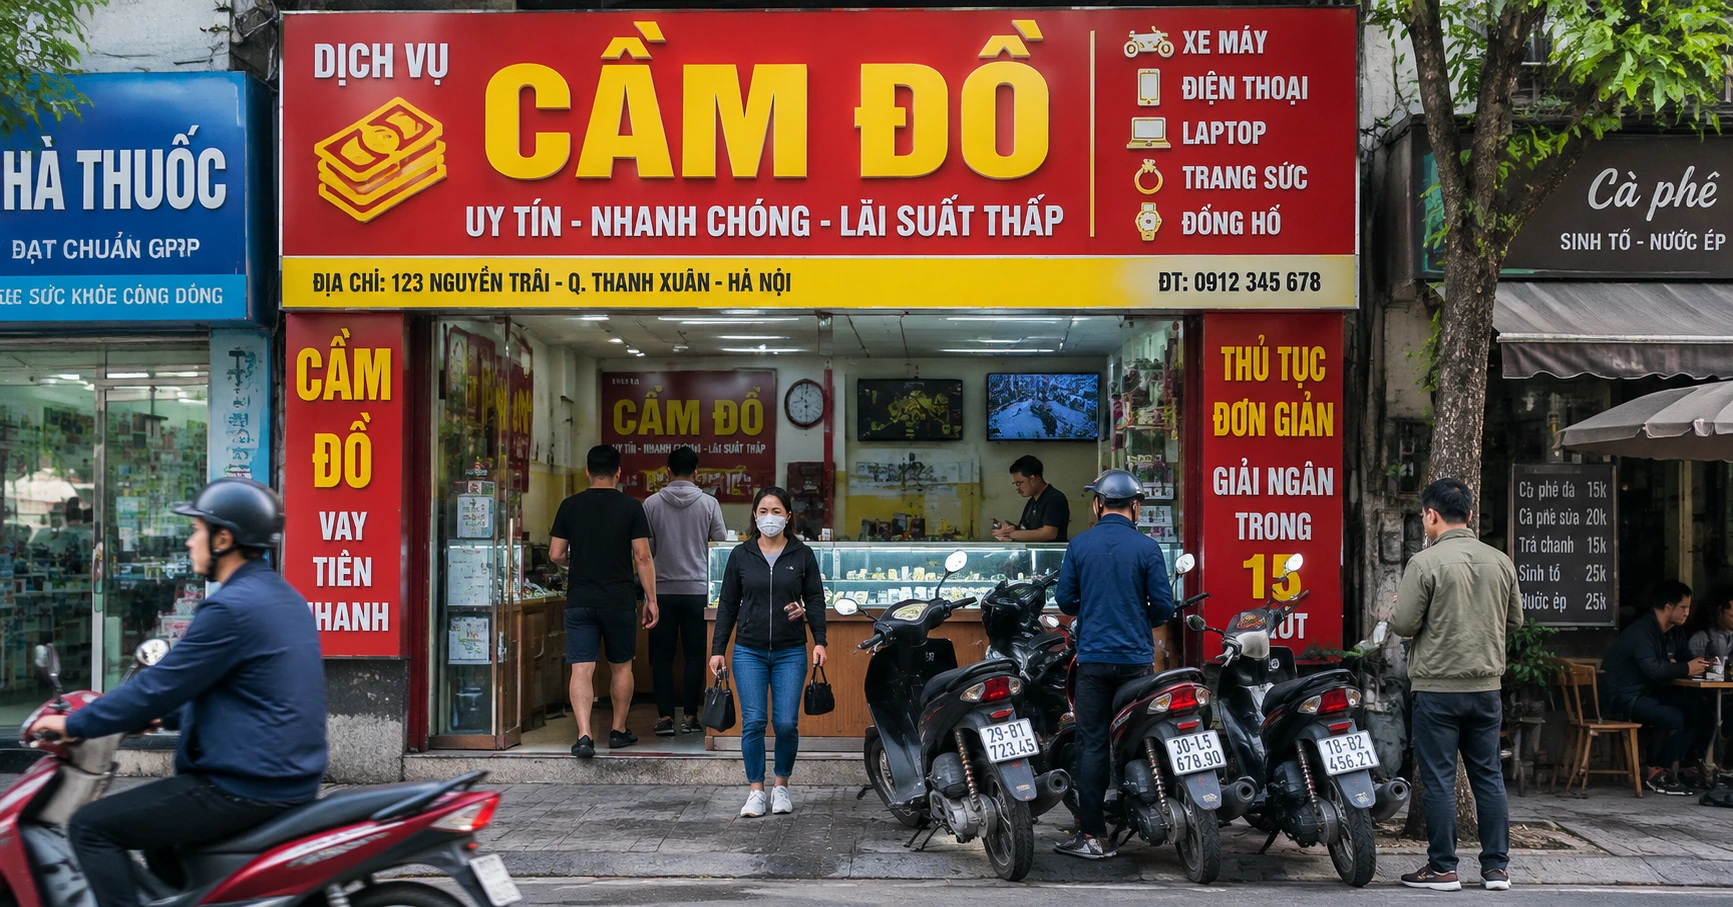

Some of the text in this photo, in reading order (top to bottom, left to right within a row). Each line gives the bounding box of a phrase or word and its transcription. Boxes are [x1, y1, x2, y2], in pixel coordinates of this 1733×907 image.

[1183, 25, 1268, 54] XE MÁY
[314, 43, 448, 86] DỊCH VỤ
[484, 20, 1049, 180] CẦM ĐỒ
[1182, 70, 1308, 105] ĐIỆN THOẠI
[1183, 121, 1267, 145] LAPTOP
[76, 125, 227, 211] THUỐC
[1182, 161, 1308, 190] TRANG SỨC
[1587, 165, 1720, 222] Cà phê
[466, 206, 504, 237] UY
[513, 198, 562, 237] TÍN
[591, 206, 696, 237] NHANH
[707, 198, 810, 237] CHÓNG
[820, 219, 831, 227] -
[897, 194, 975, 237] SUẤT
[984, 194, 1064, 237] THẤP
[12, 239, 57, 264] ĐẠT
[1560, 232, 1601, 250] SINH
[1608, 228, 1634, 250] TỐ
[1650, 229, 1697, 250] NƯỚC
[1704, 229, 1726, 250] ÉP
[313, 273, 343, 297] ĐỊA
[392, 273, 423, 292] 123
[568, 272, 586, 295] Q.
[592, 273, 653, 292] THANH
[1159, 272, 1321, 292] ĐT: 0912 345 678
[296, 328, 391, 402] CẦM
[1221, 334, 1326, 389] THỦ TỤC
[1213, 391, 1334, 437] ĐƠN GIẢN
[312, 412, 372, 489] ĐỒ
[1213, 458, 1334, 496] GIẢI NGÂN
[1587, 481, 1607, 498] 15k
[318, 511, 367, 541] VAY
[1235, 512, 1312, 541] TRONG
[1586, 508, 1607, 525] 20k
[1540, 535, 1574, 553] chanh
[1587, 536, 1607, 554] 15k
[312, 549, 372, 587] TIỀN
[1243, 553, 1302, 602] 15
[1519, 564, 1544, 582] Sinh
[1585, 564, 1607, 582] 25k
[1585, 592, 1607, 610] 25k
[987, 722, 1025, 744] 29-B1
[1173, 733, 1213, 755] 30-L5
[1326, 736, 1365, 756] 18-B2
[989, 738, 1035, 760] 723.45
[1176, 749, 1222, 772] 678.90
[1329, 750, 1374, 772] 456.21
